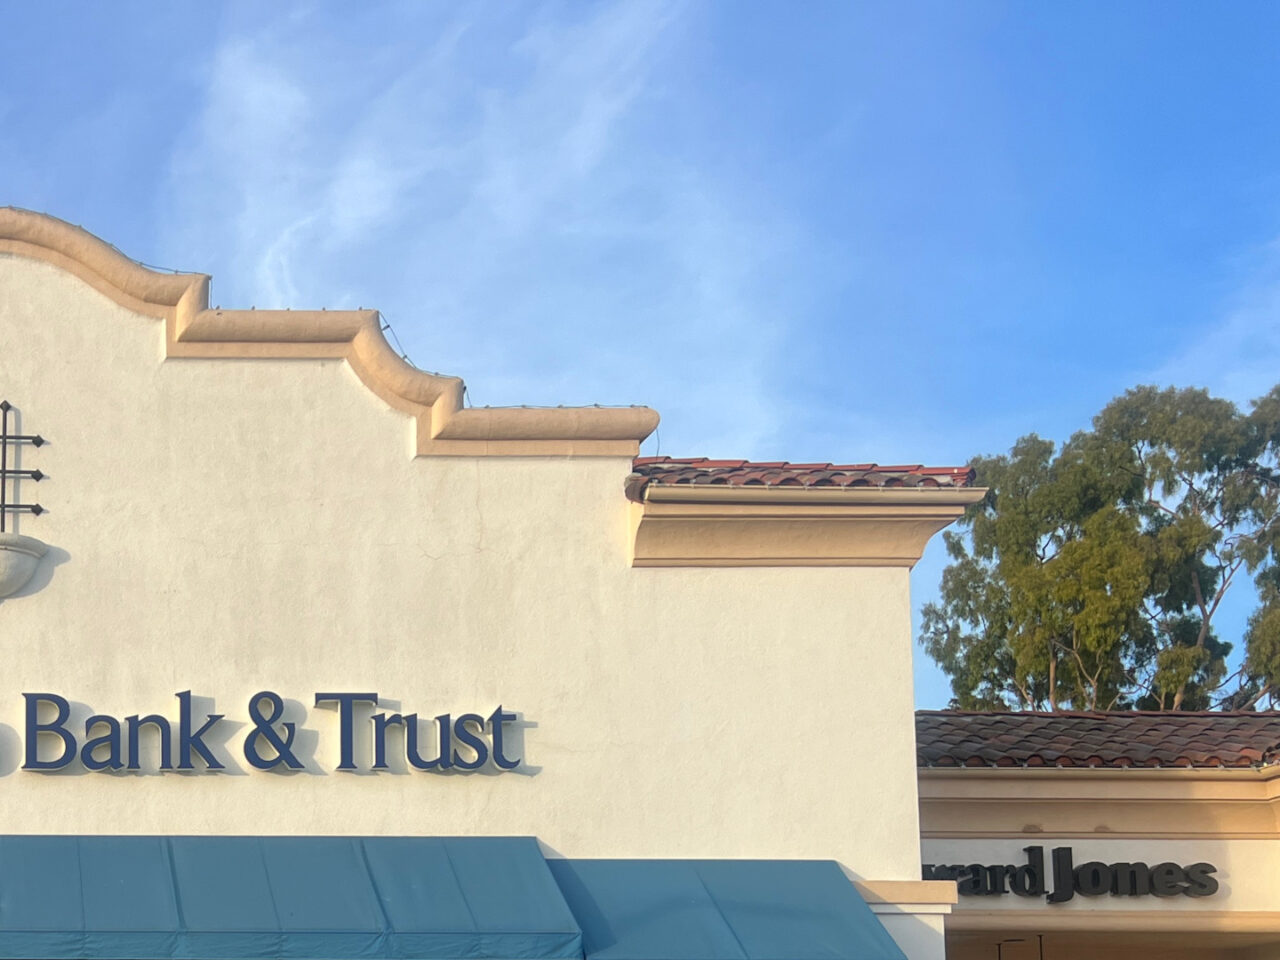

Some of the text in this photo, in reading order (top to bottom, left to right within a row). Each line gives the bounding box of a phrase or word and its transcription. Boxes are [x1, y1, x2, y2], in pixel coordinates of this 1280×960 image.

[21, 690, 226, 771] Bank
[243, 690, 306, 770] &
[315, 692, 521, 771] Trust
[1047, 847, 1219, 904] Jones
